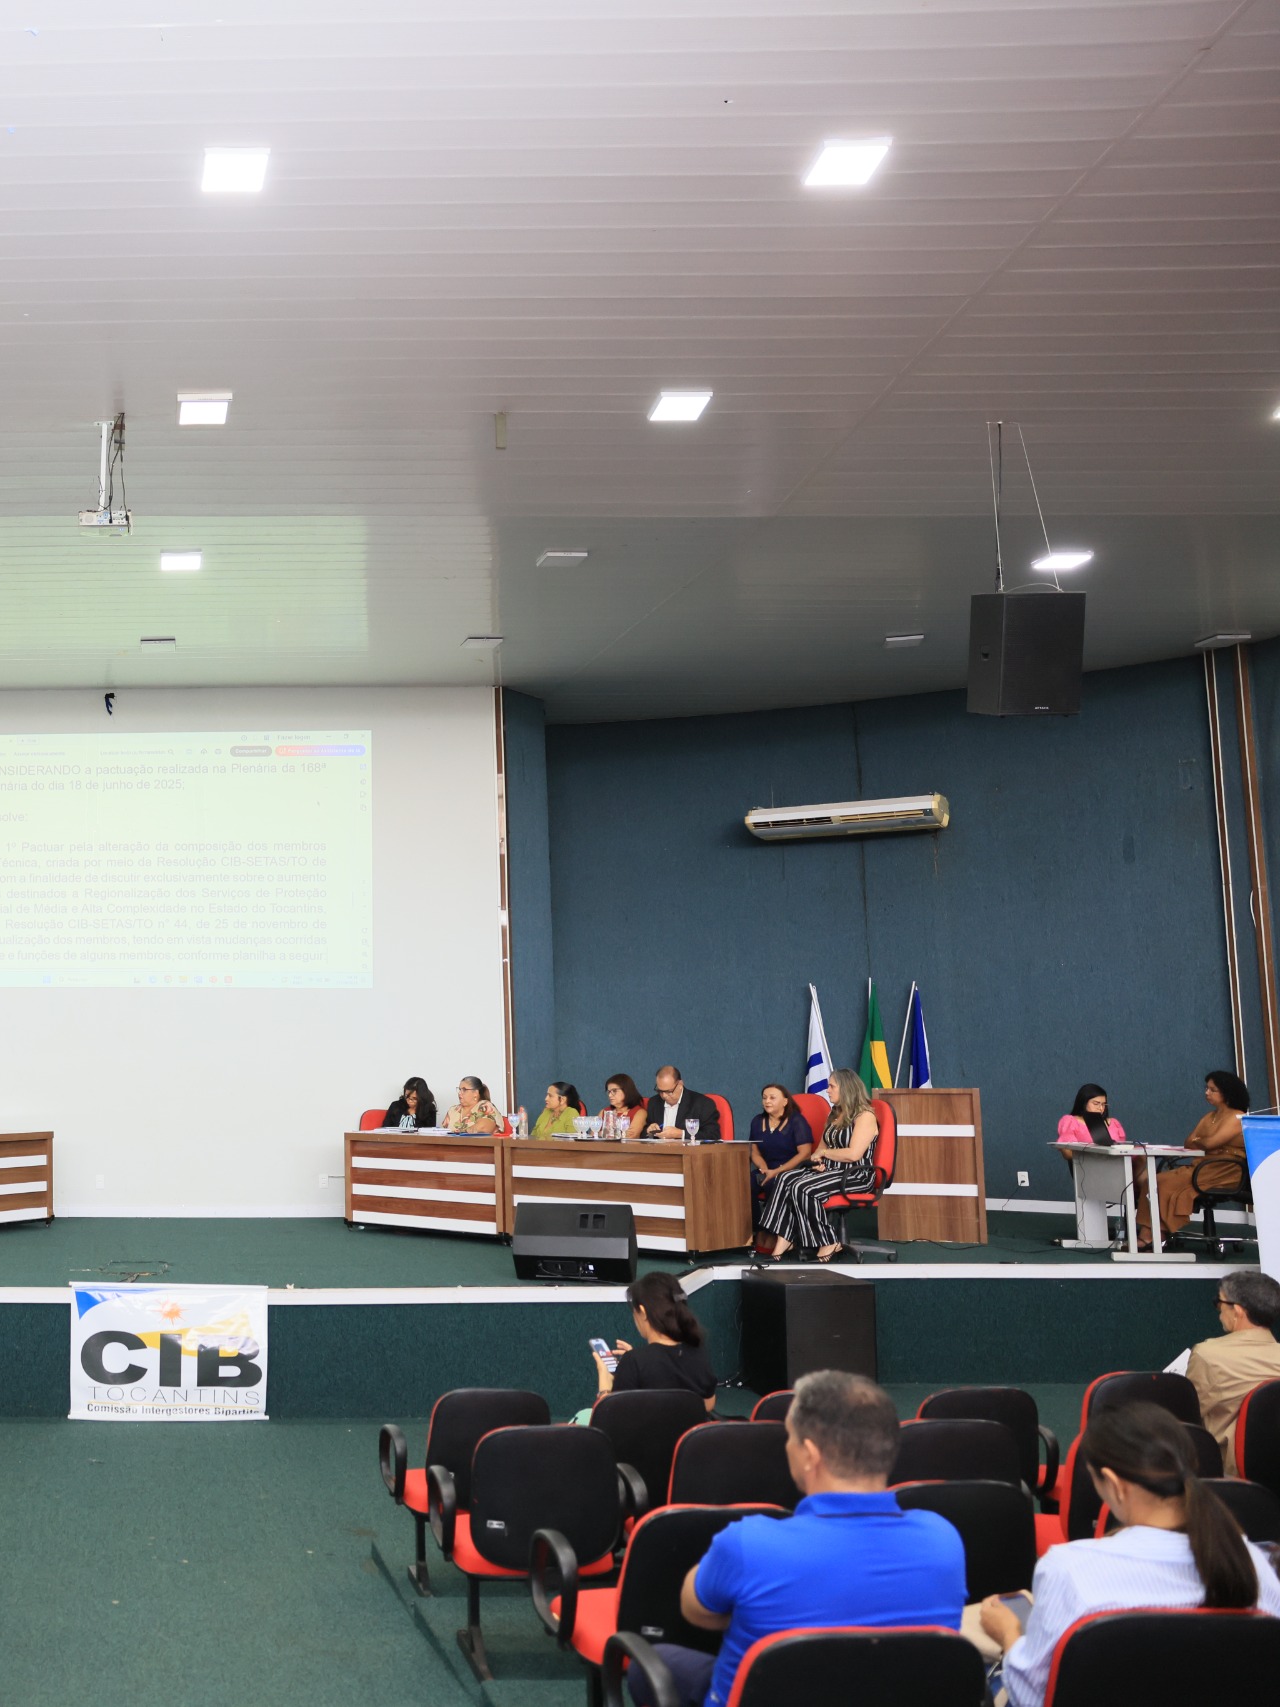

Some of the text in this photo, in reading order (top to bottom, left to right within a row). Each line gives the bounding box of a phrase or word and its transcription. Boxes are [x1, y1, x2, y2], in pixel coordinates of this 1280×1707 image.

[96, 764, 153, 776] pactuação
[157, 763, 208, 774] realizada
[212, 765, 226, 773] na
[231, 763, 276, 773] Plenária
[282, 762, 295, 773] da
[31, 780, 44, 790] do
[48, 780, 64, 790] dia
[69, 780, 81, 790] 18
[85, 780, 98, 789] de
[102, 779, 132, 792] junho
[136, 779, 150, 789] de
[154, 779, 184, 790] 2025;
[21, 841, 64, 852] Pactuar
[69, 840, 94, 853] pela
[98, 841, 150, 853] alteração
[155, 841, 168, 851] da
[174, 841, 241, 853] composição
[247, 840, 267, 850] dos
[273, 840, 326, 850] membros
[46, 857, 79, 867] criada
[84, 857, 102, 869] por
[106, 857, 133, 866] meio
[137, 856, 151, 866] da
[157, 856, 216, 868] Resolução
[221, 856, 307, 866] CIB-SETAS/TO
[312, 856, 326, 866] de
[29, 872, 81, 882] finalidade
[84, 873, 98, 882] de
[100, 872, 140, 882] discutir
[143, 872, 229, 882] exclusivamente
[232, 872, 264, 881] sobre
[276, 873, 326, 881] aumento
[6, 888, 66, 898] destinados
[84, 888, 170, 900] Regionalização
[175, 887, 196, 897] dos
[201, 888, 250, 900] Serviços
[256, 888, 270, 897] de
[275, 887, 326, 900] Proteção
[16, 903, 30, 913] de
[34, 903, 67, 913] Média
[81, 903, 102, 913] Alta
[106, 903, 187, 914] Complexidade
[209, 903, 247, 913] Estado
[252, 903, 265, 912] do
[5, 919, 63, 931] Resolução
[68, 918, 153, 928] CIB-SETAS/TO
[196, 919, 210, 928] de
[214, 918, 228, 928] 25
[233, 919, 246, 928] de
[252, 919, 308, 928] novembro
[312, 919, 326, 928] de
[52, 935, 72, 944] dos
[132, 934, 163, 944] tendo
[186, 935, 211, 944] vista
[214, 935, 272, 946] mudanças
[275, 935, 326, 944] ocorridas
[17, 950, 60, 961] funções
[63, 950, 76, 959] de
[80, 950, 116, 962] alguns
[177, 950, 229, 960] conforme
[233, 950, 275, 961] planilha
[80, 1330, 262, 1388] CIB
[88, 1386, 260, 1406] TOCANTINS
[87, 1403, 138, 1414] Comissão
[141, 1406, 210, 1416] Intergestores
